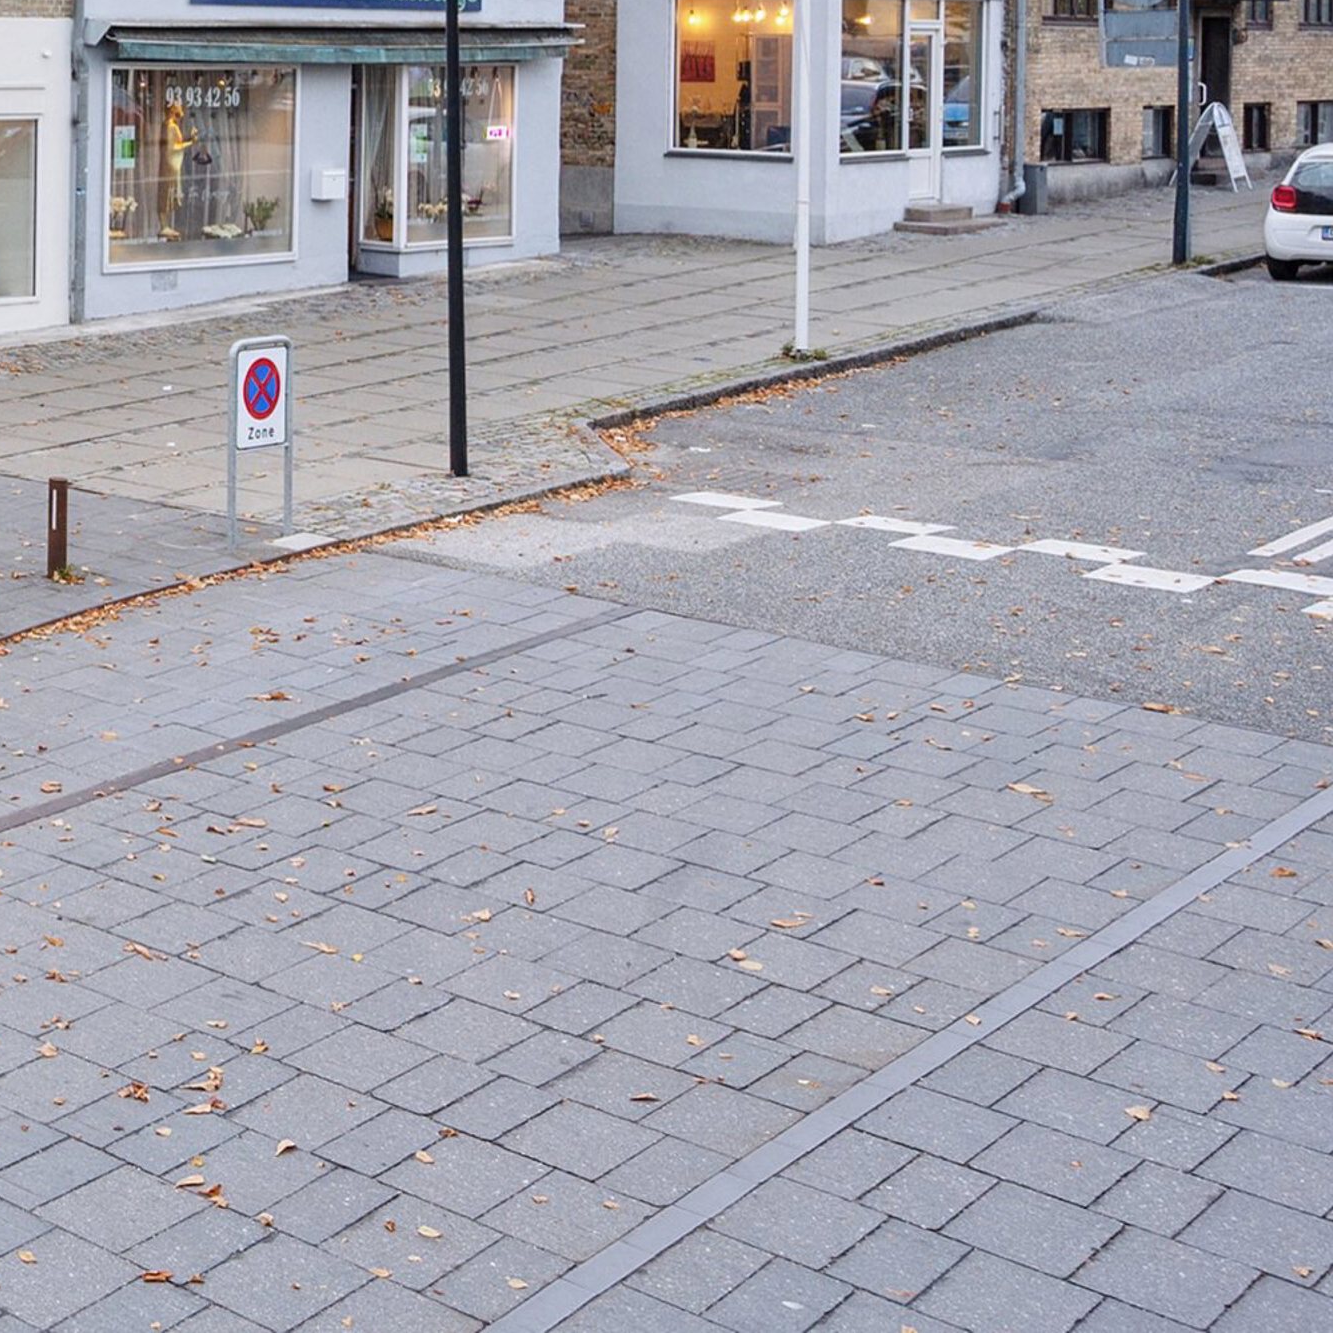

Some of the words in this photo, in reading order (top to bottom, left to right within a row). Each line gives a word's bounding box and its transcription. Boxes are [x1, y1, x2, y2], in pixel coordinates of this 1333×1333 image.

[166, 87, 182, 107] 93
[186, 86, 202, 107] 93
[204, 86, 221, 107] 42
[224, 87, 240, 107] 56
[248, 426, 275, 440] Zone
